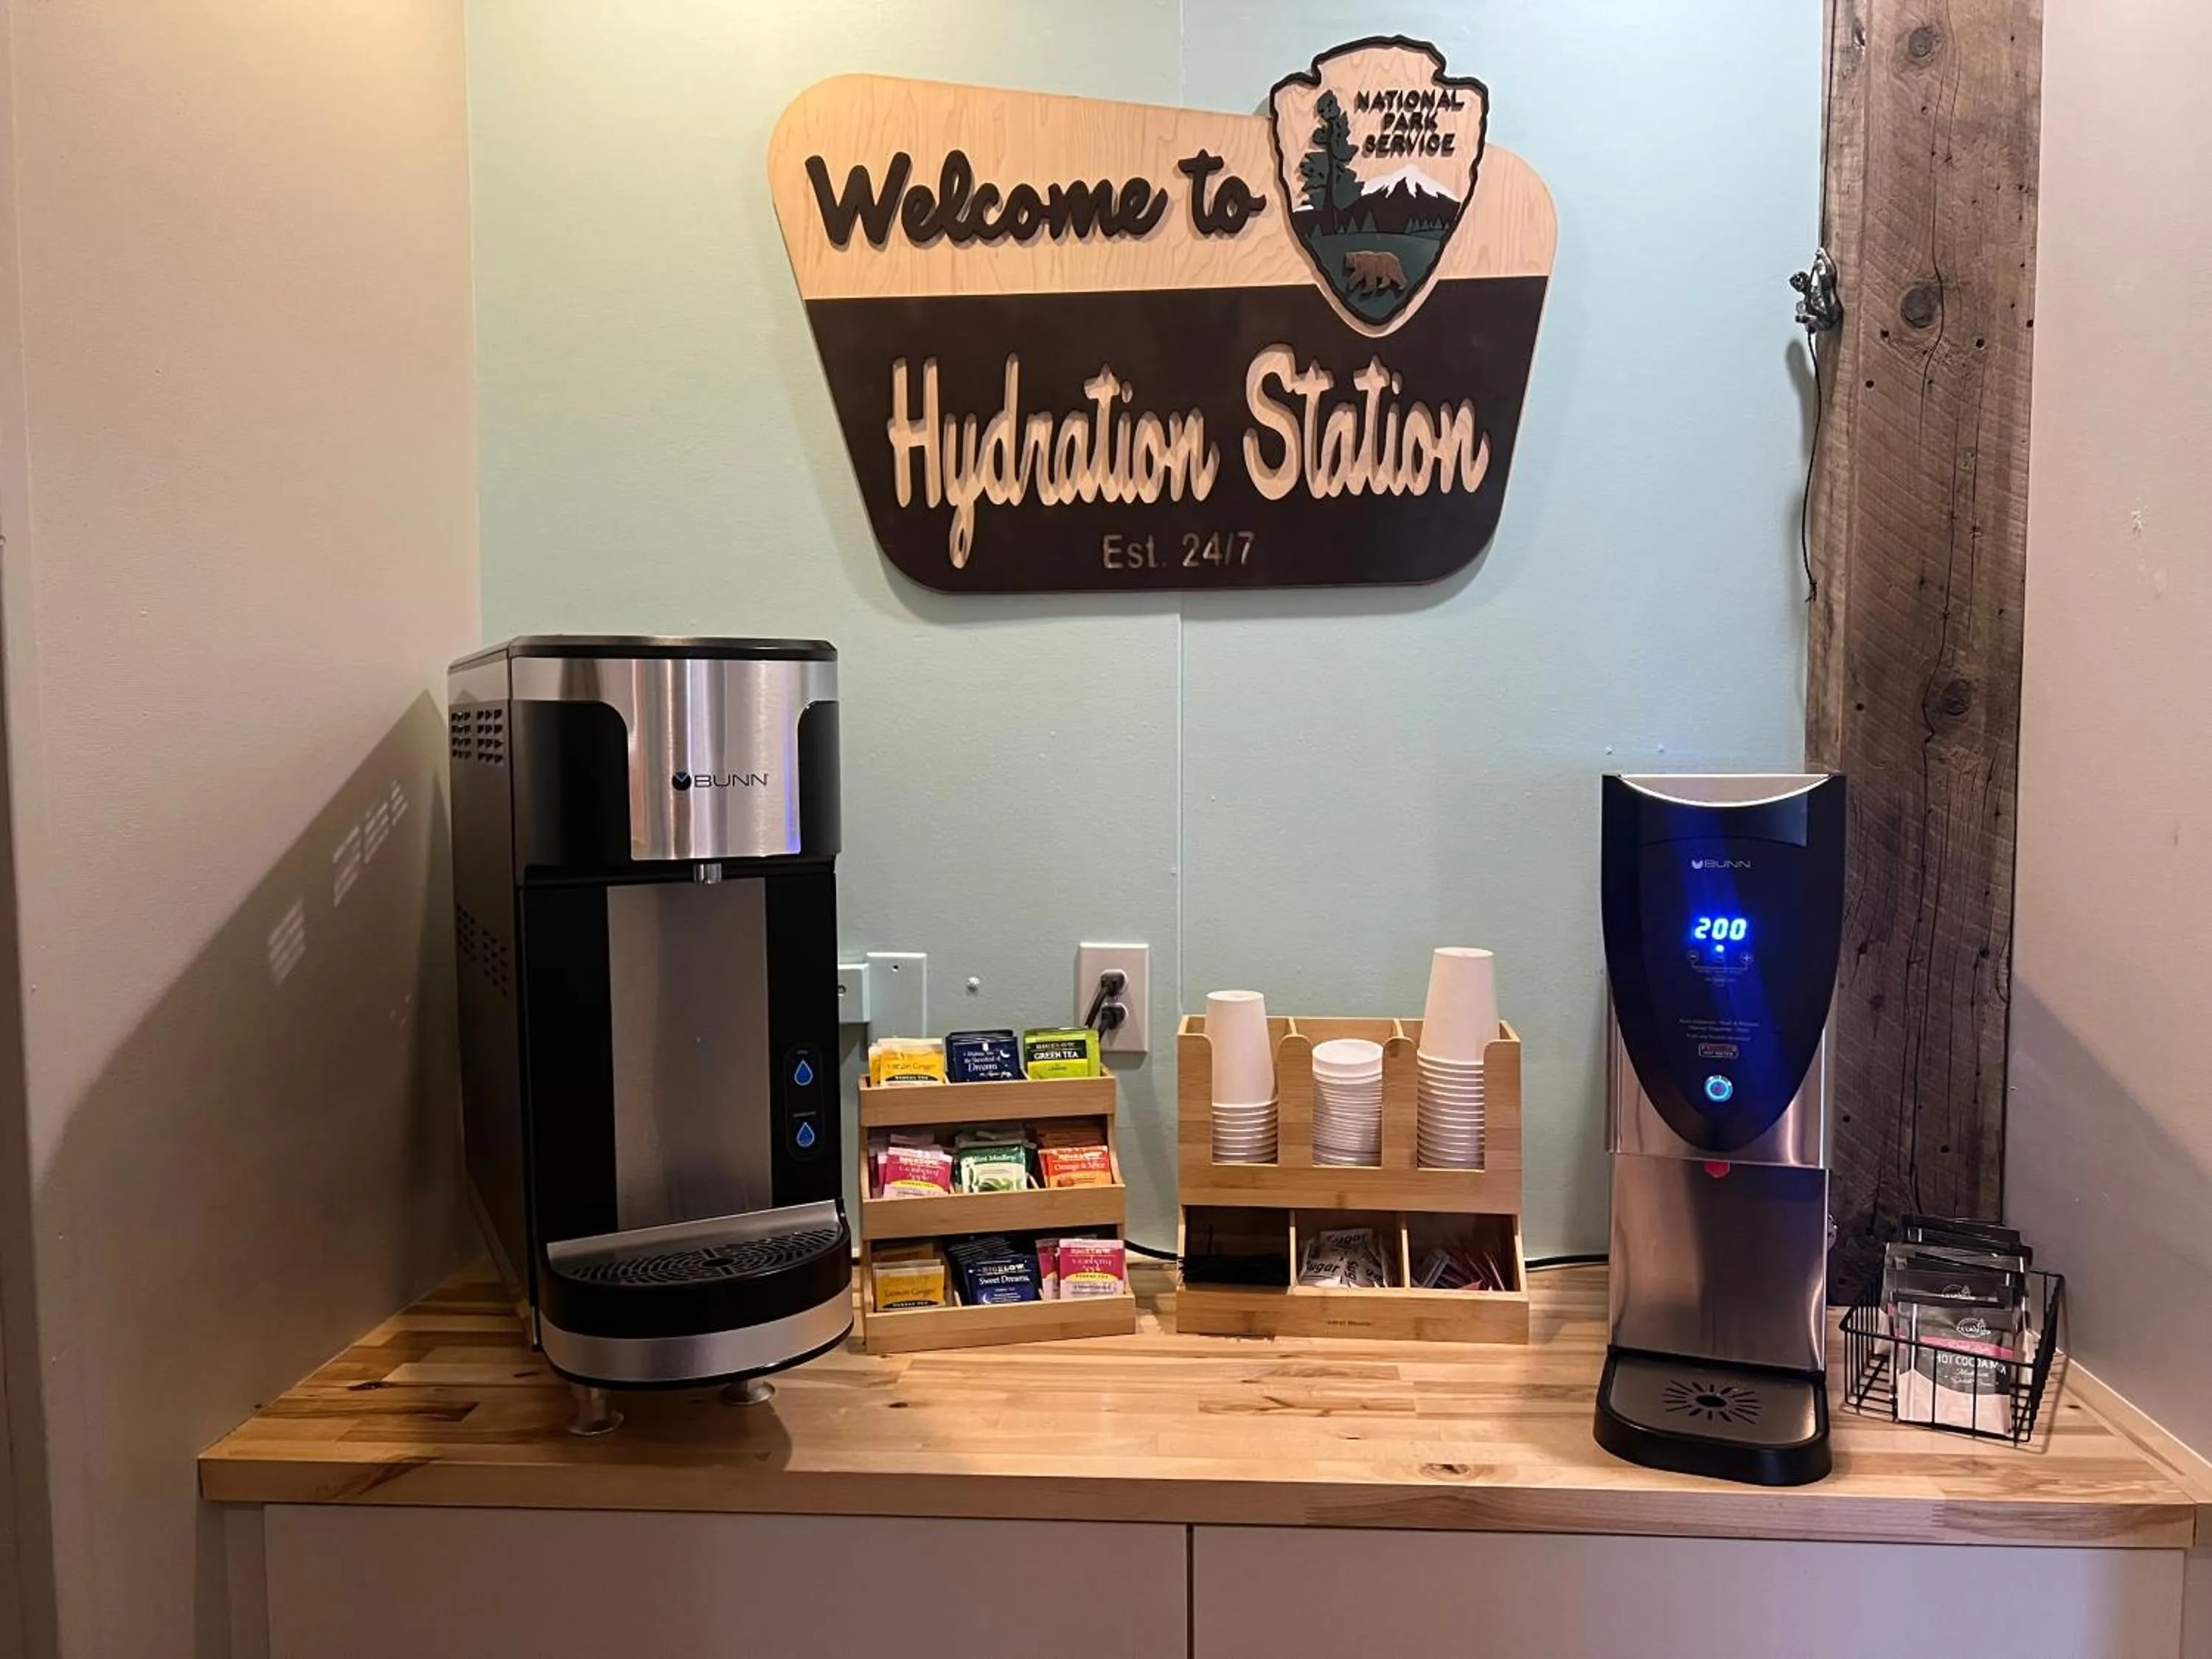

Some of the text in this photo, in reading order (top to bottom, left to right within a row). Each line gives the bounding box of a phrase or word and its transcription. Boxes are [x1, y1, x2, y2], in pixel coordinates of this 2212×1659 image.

[1354, 88, 1465, 114] NATIONAL
[1380, 111, 1438, 135] PARK
[1362, 133, 1455, 159] SERVICE
[804, 149, 1267, 246] Welcome to
[887, 343, 1490, 569] Hydration Station
[1102, 531, 1256, 569] Est. 24/7
[694, 773, 769, 789] BUNN
[1704, 859, 1752, 869] BUNN
[1694, 917, 1747, 941] 200
[1034, 1050, 1079, 1060] GREEN TEA
[978, 1274, 1030, 1285] Sweet Dreams
[1937, 1353, 1953, 1365] HOT
